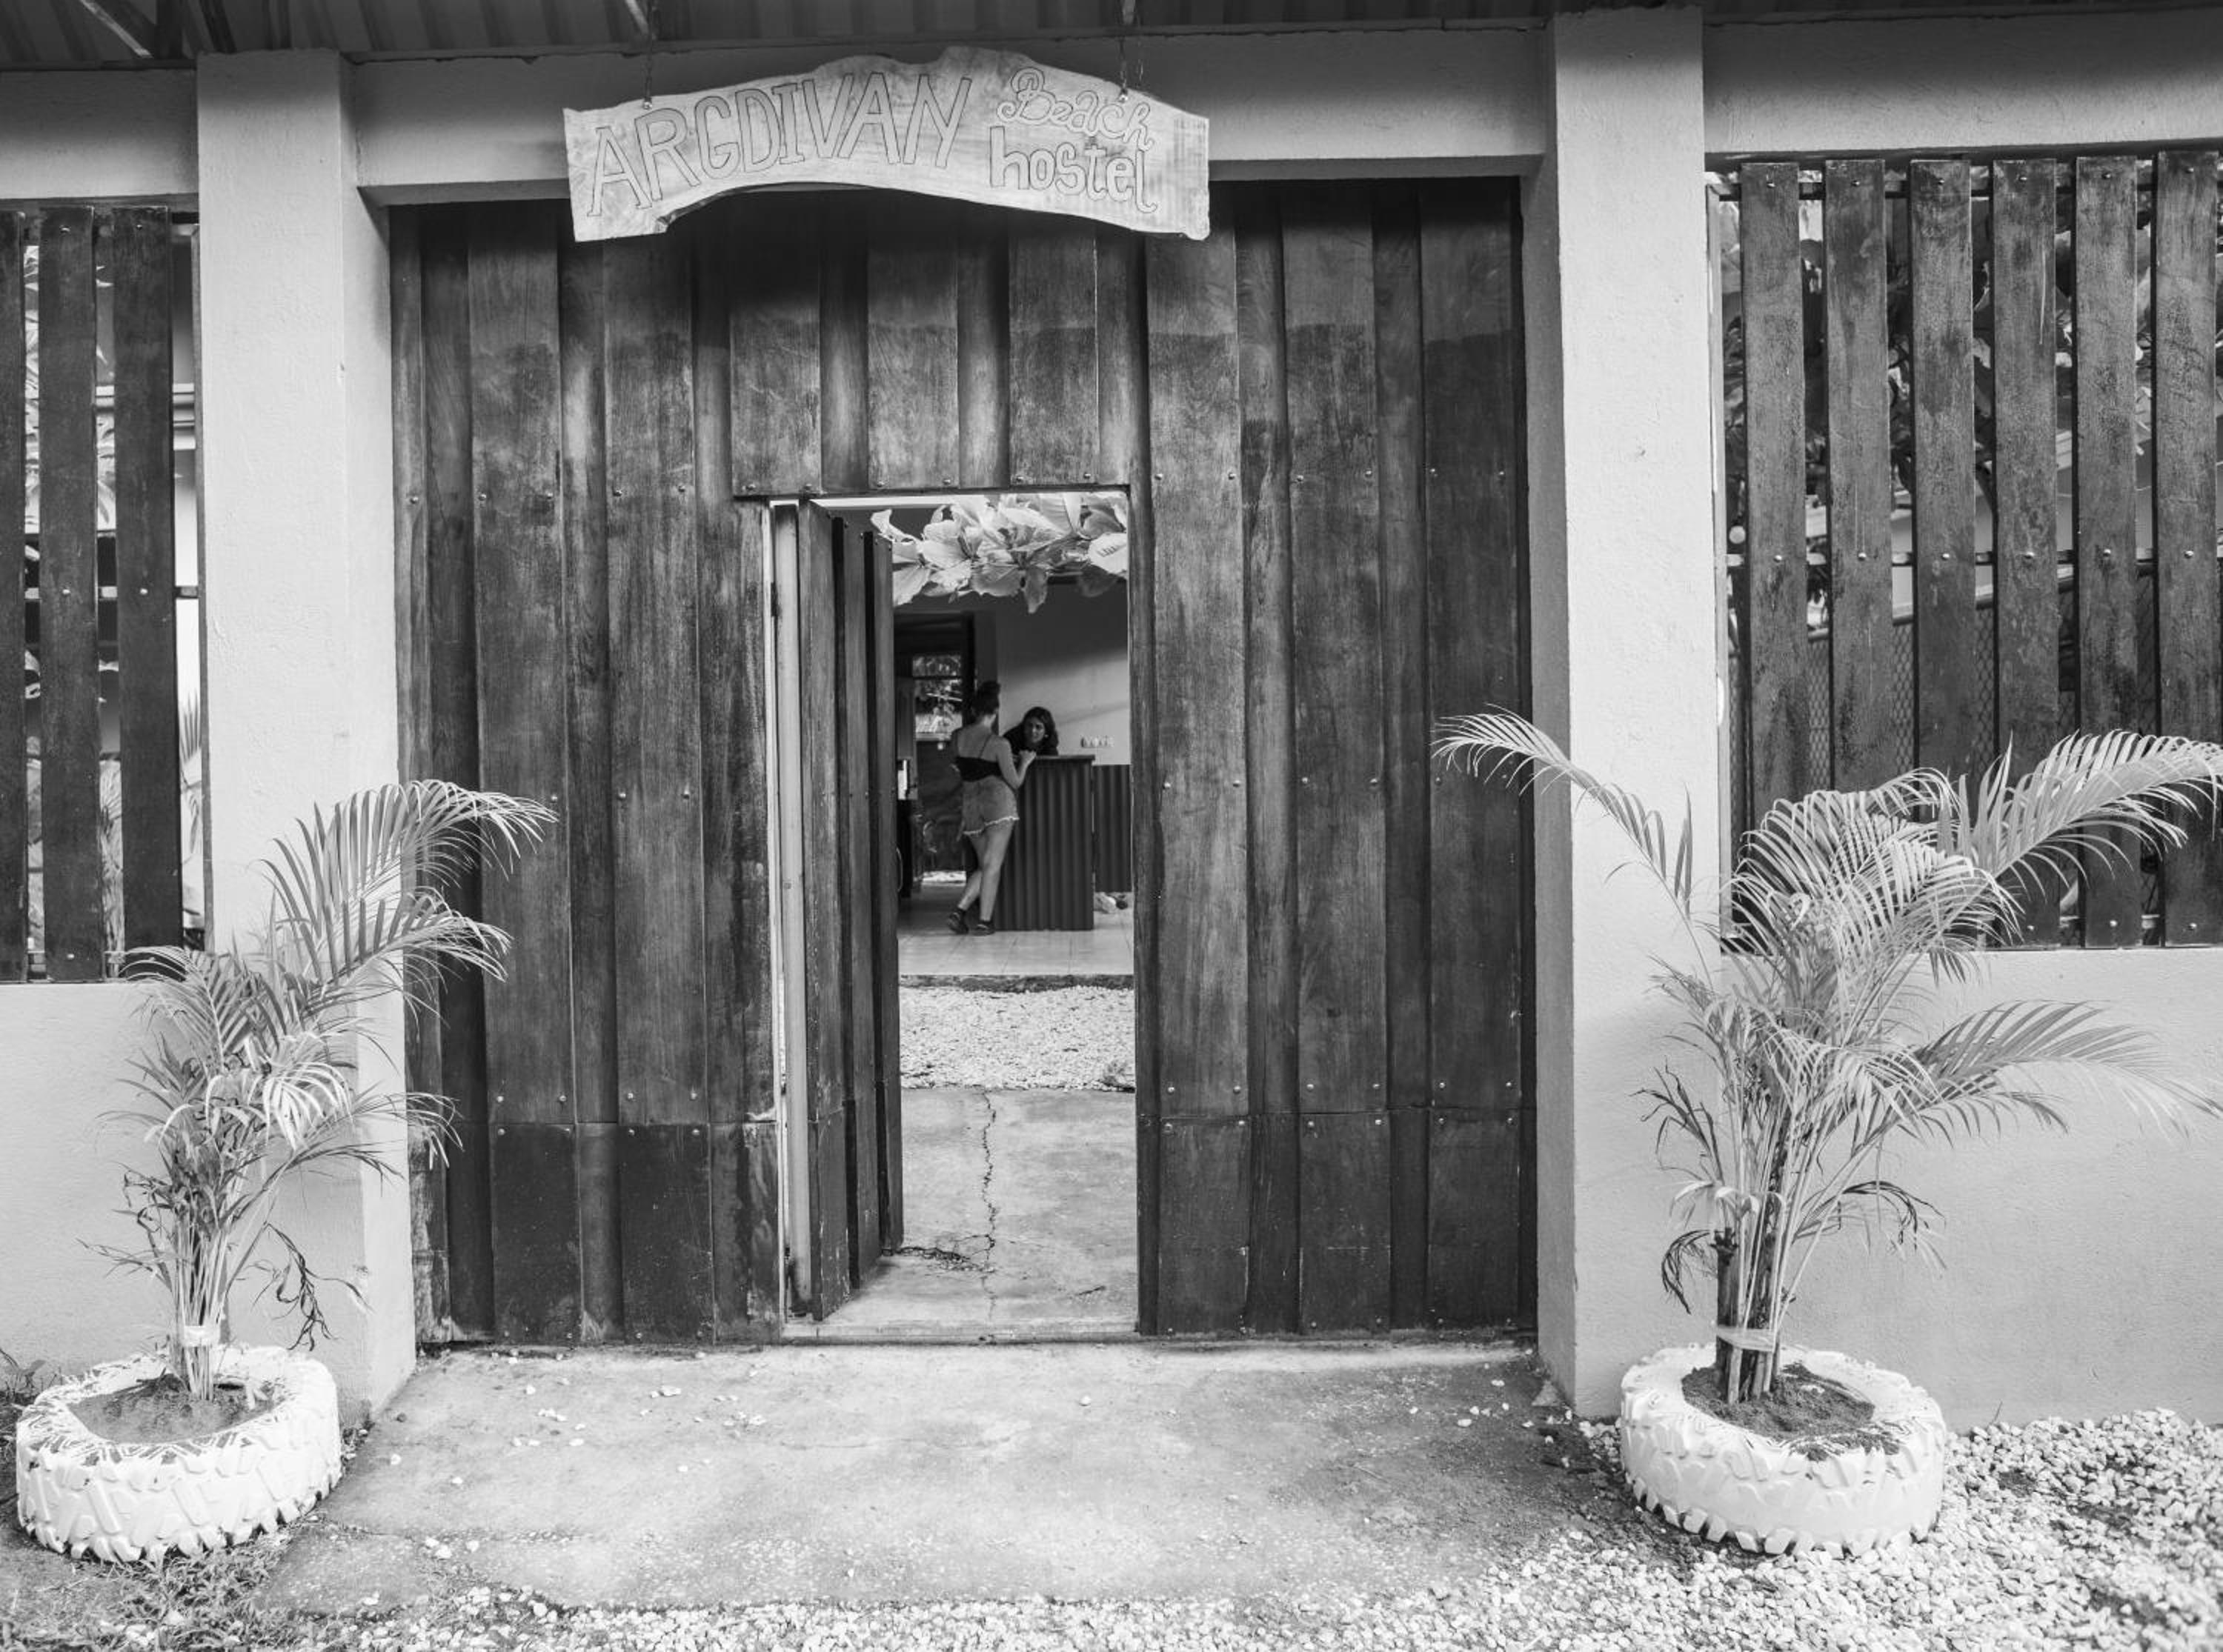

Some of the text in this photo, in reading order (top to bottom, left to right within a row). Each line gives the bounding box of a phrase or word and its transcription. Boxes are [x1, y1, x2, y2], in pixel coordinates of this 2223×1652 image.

[587, 71, 973, 217] ARGDIVAN
[997, 67, 1154, 151] Beach
[989, 125, 1158, 213] hostel
